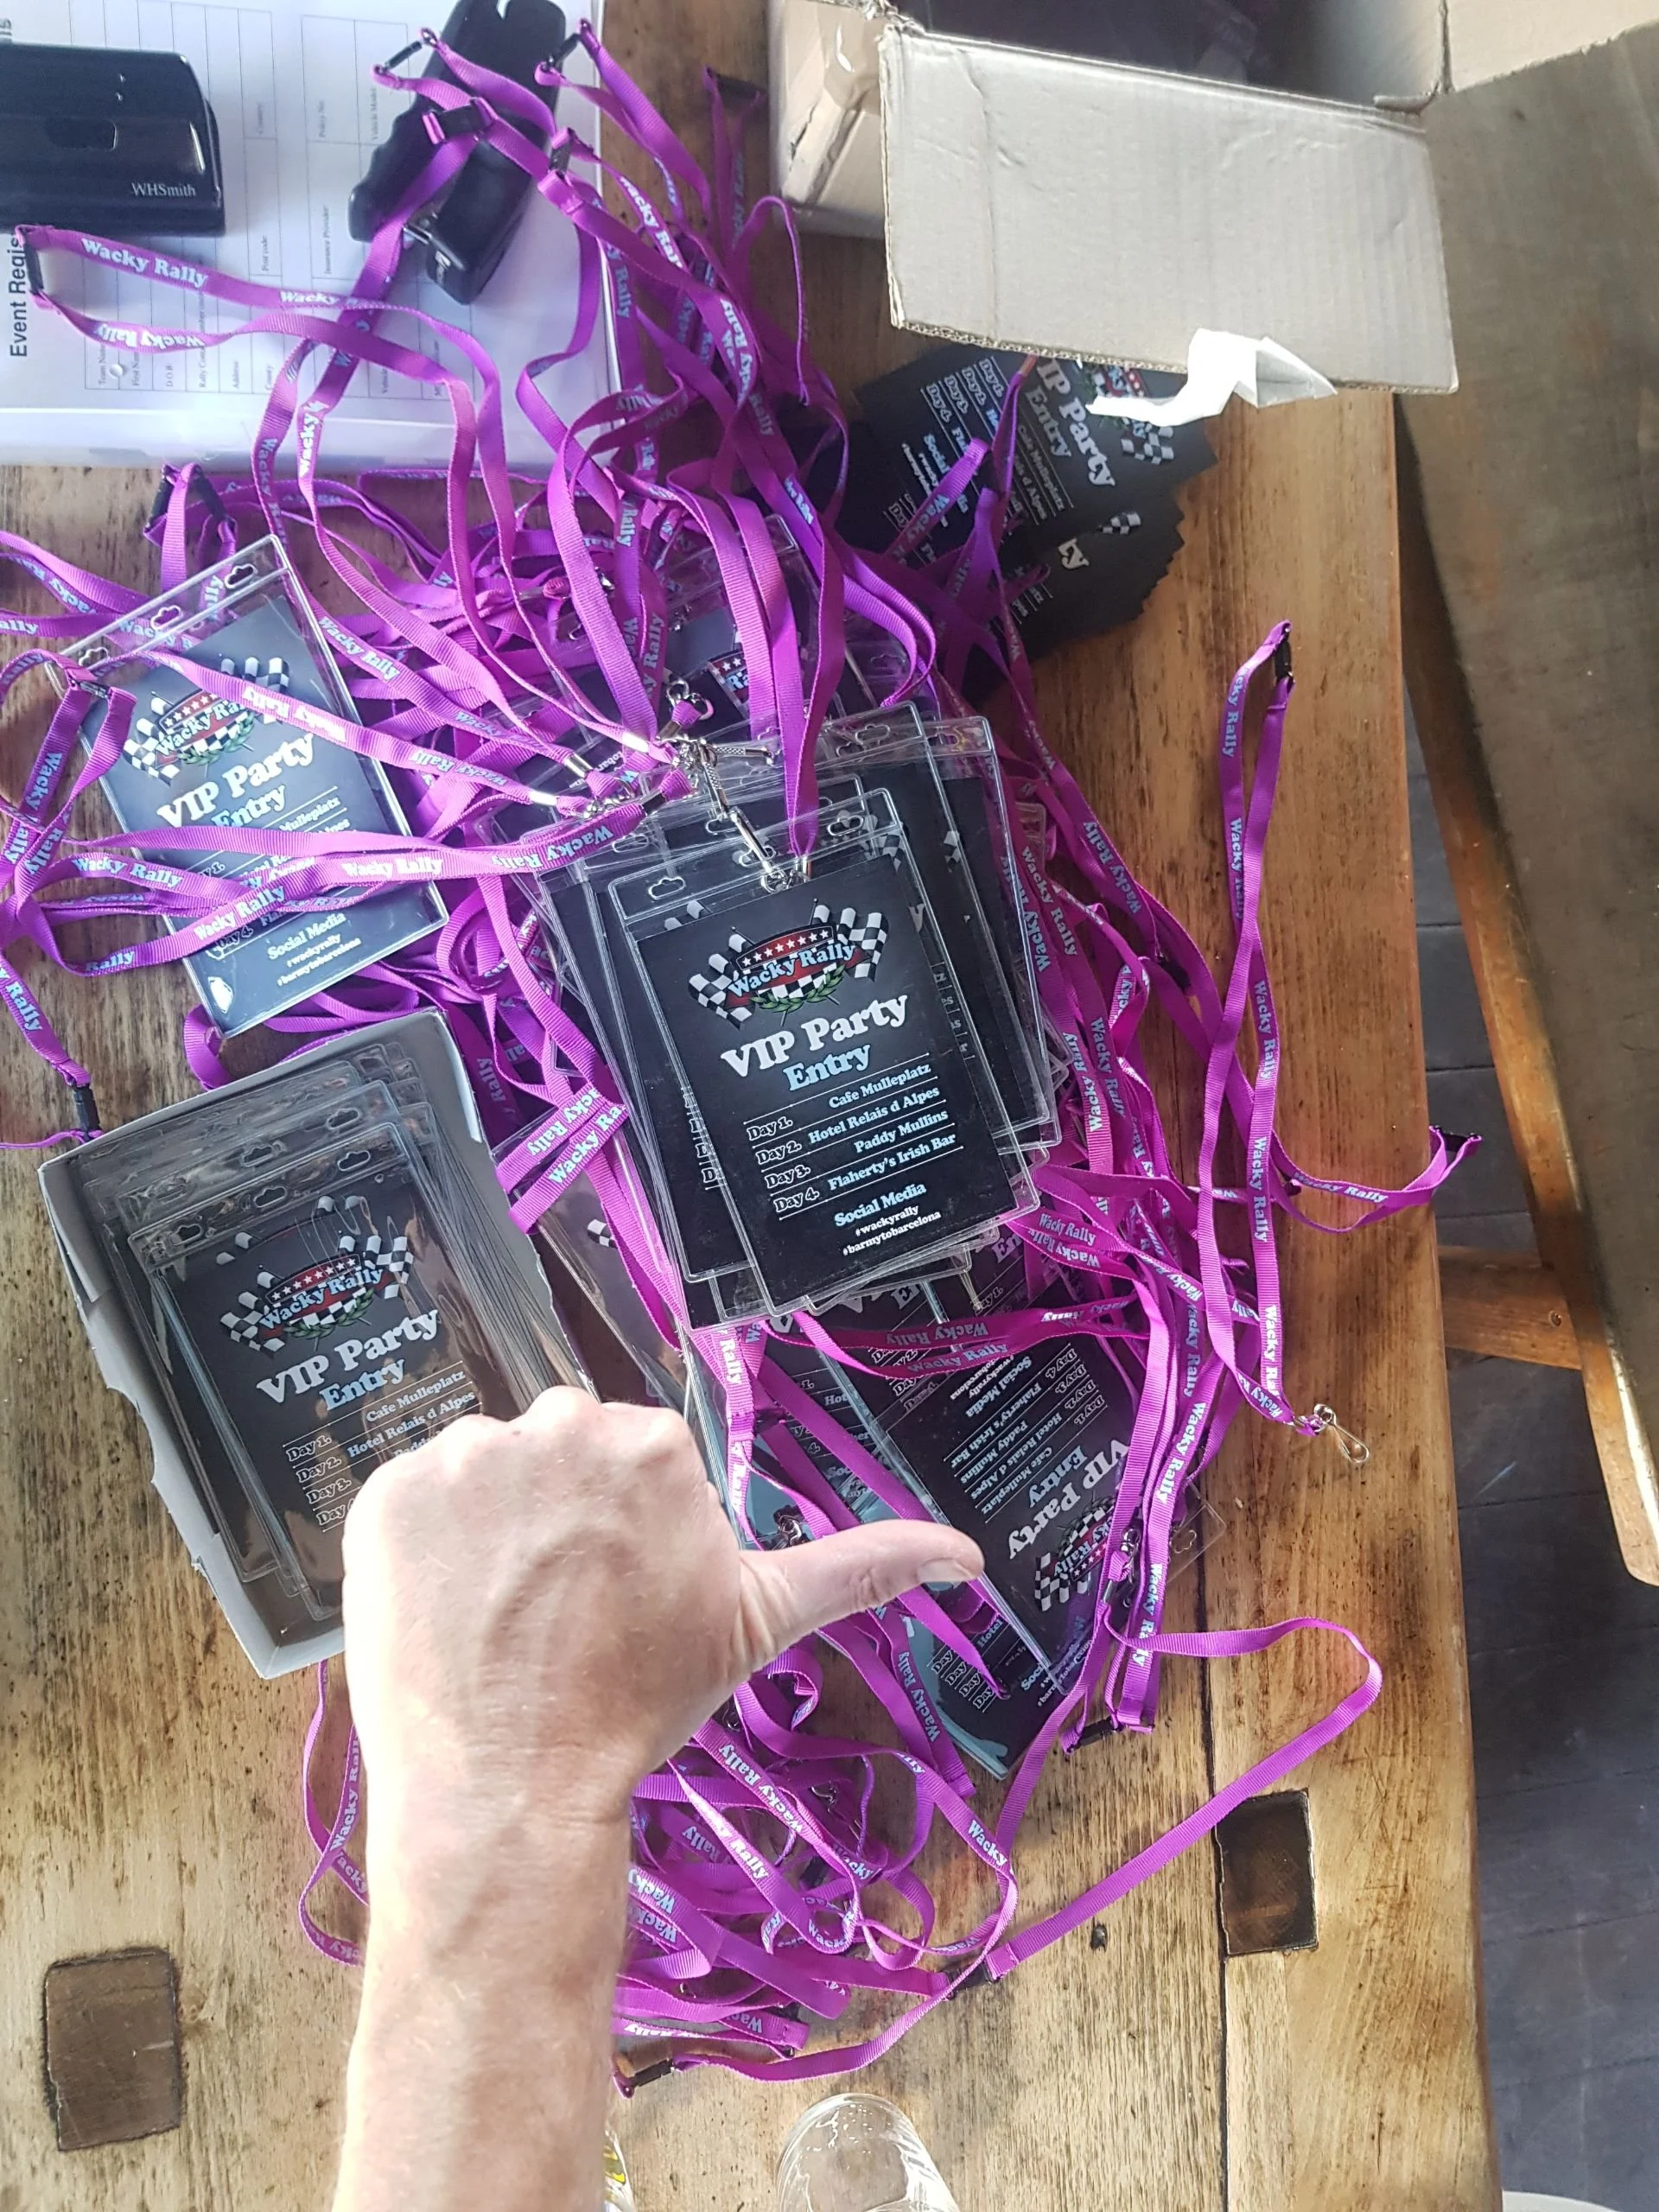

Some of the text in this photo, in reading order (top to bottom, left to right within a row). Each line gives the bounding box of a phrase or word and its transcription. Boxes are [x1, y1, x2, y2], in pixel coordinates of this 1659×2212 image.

[130, 181, 197, 198] WHSmith
[81, 238, 208, 289] Wacky Rally
[280, 290, 340, 306] Wacky
[614, 265, 632, 320] Rally
[9, 300, 28, 358] Event
[141, 330, 206, 350] Wacky
[1025, 385, 1072, 457] Entry
[1058, 396, 1116, 486] Party
[923, 433, 950, 474] Social
[616, 508, 639, 548] Rally
[317, 616, 401, 681] Wacky Rally
[642, 612, 665, 670] Rally
[156, 707, 216, 756] Wacky
[1221, 710, 1241, 759] Rally
[24, 752, 63, 811] Wacky
[157, 733, 315, 830] VIP Party
[410, 749, 508, 786] Wacky Rally
[211, 783, 286, 828] Entry
[23, 827, 64, 876] Rally
[340, 856, 443, 879] Wacky Rally
[545, 824, 615, 863] Wacky
[1230, 817, 1243, 873] Wacky
[73, 856, 127, 874] Wacky
[130, 862, 185, 889] Rally
[1083, 821, 1142, 915] Rally Wacky
[193, 910, 237, 942] Wacky
[235, 885, 286, 918] Rally
[1020, 846, 1078, 957] Wacky Rally
[266, 929, 307, 962] Social
[307, 911, 347, 941] Media
[285, 931, 343, 969] #wackyrally
[85, 950, 135, 972] Rally
[728, 941, 856, 998] Wacky Rally
[5, 982, 43, 1032] Rally
[1254, 979, 1276, 1080] Wacky Rally
[720, 995, 908, 1078] VIP Party
[1090, 1016, 1113, 1074] Wacky
[475, 1056, 508, 1104] Rally
[782, 1044, 871, 1092] Entry
[828, 1063, 932, 1109] Cafe Mulleplatz
[807, 1086, 941, 1145] Hotel Relais d Alpes
[1081, 1075, 1104, 1133] Wacky
[527, 1120, 569, 1157] Rally
[746, 1121, 777, 1141] Day
[755, 1140, 803, 1166] Day 2.
[854, 1109, 950, 1154] Paddy Mullins
[548, 1129, 600, 1185] Wacky
[765, 1163, 812, 1190] Day 3.
[826, 1134, 957, 1192] Flaherty's Irish Bar
[773, 1186, 821, 1214] Day 4.
[833, 1181, 928, 1228] Social Media
[1249, 1135, 1270, 1243] Wacky Rally
[1344, 1185, 1389, 1205] Rally
[841, 1210, 942, 1256] #barmytobarcelona
[854, 1204, 921, 1237] #wackyrally
[1039, 1212, 1096, 1247] Wacky Rally
[1055, 1242, 1102, 1269] Wacky
[258, 1268, 384, 1330] Wacky Rally
[255, 1308, 440, 1404] VIP Party
[887, 1322, 989, 1346] Wacky Rally
[907, 1355, 962, 1374] Wacky
[962, 1341, 1008, 1362] Rally
[1263, 1305, 1279, 1363] Wacky
[719, 1338, 743, 1386] Rally
[1056, 1348, 1078, 1369] Day
[1065, 1363, 1088, 1383] Day
[1182, 1352, 1200, 1398] Rally
[319, 1358, 406, 1411] Entry
[365, 1370, 467, 1423] Cafe Mulleplatz
[964, 1356, 1033, 1419] Social Media
[1075, 1379, 1097, 1400] Day
[1084, 1394, 1106, 1415] Day
[346, 1390, 476, 1458] Hotel Relais d Alpes
[950, 1382, 1043, 1470] Flaherty's Irish Bar
[286, 1441, 315, 1462] Day
[296, 1456, 343, 1484] Day 2.
[960, 1419, 1029, 1484] Paddy Mullins
[969, 1412, 1063, 1501] Hotel Relais Alpes
[1081, 1439, 1131, 1492] VIP
[1154, 1401, 1207, 1506] Wacky Rally
[305, 1478, 353, 1505] Day 3.
[980, 1446, 1053, 1515] Cafe Mulleplatz
[1028, 1444, 1090, 1509] Entry
[315, 1503, 346, 1526] Day
[1007, 1490, 1081, 1560] Party
[1052, 1541, 1093, 1578] Rally
[1143, 1562, 1165, 1621] Wacky
[977, 1618, 1004, 1649] Hotel
[930, 1649, 954, 1675] Day
[944, 1661, 968, 1687] Day
[958, 1671, 982, 1698] Day
[898, 1650, 917, 1688] Rally
[910, 1688, 942, 1744] Wacky
[972, 1686, 995, 1710] Day
[718, 1743, 804, 1834] Rally Wacky
[331, 1789, 358, 1852] Wacky
[967, 1820, 1008, 1867] Wacky
[728, 1834, 769, 1880] Rally
